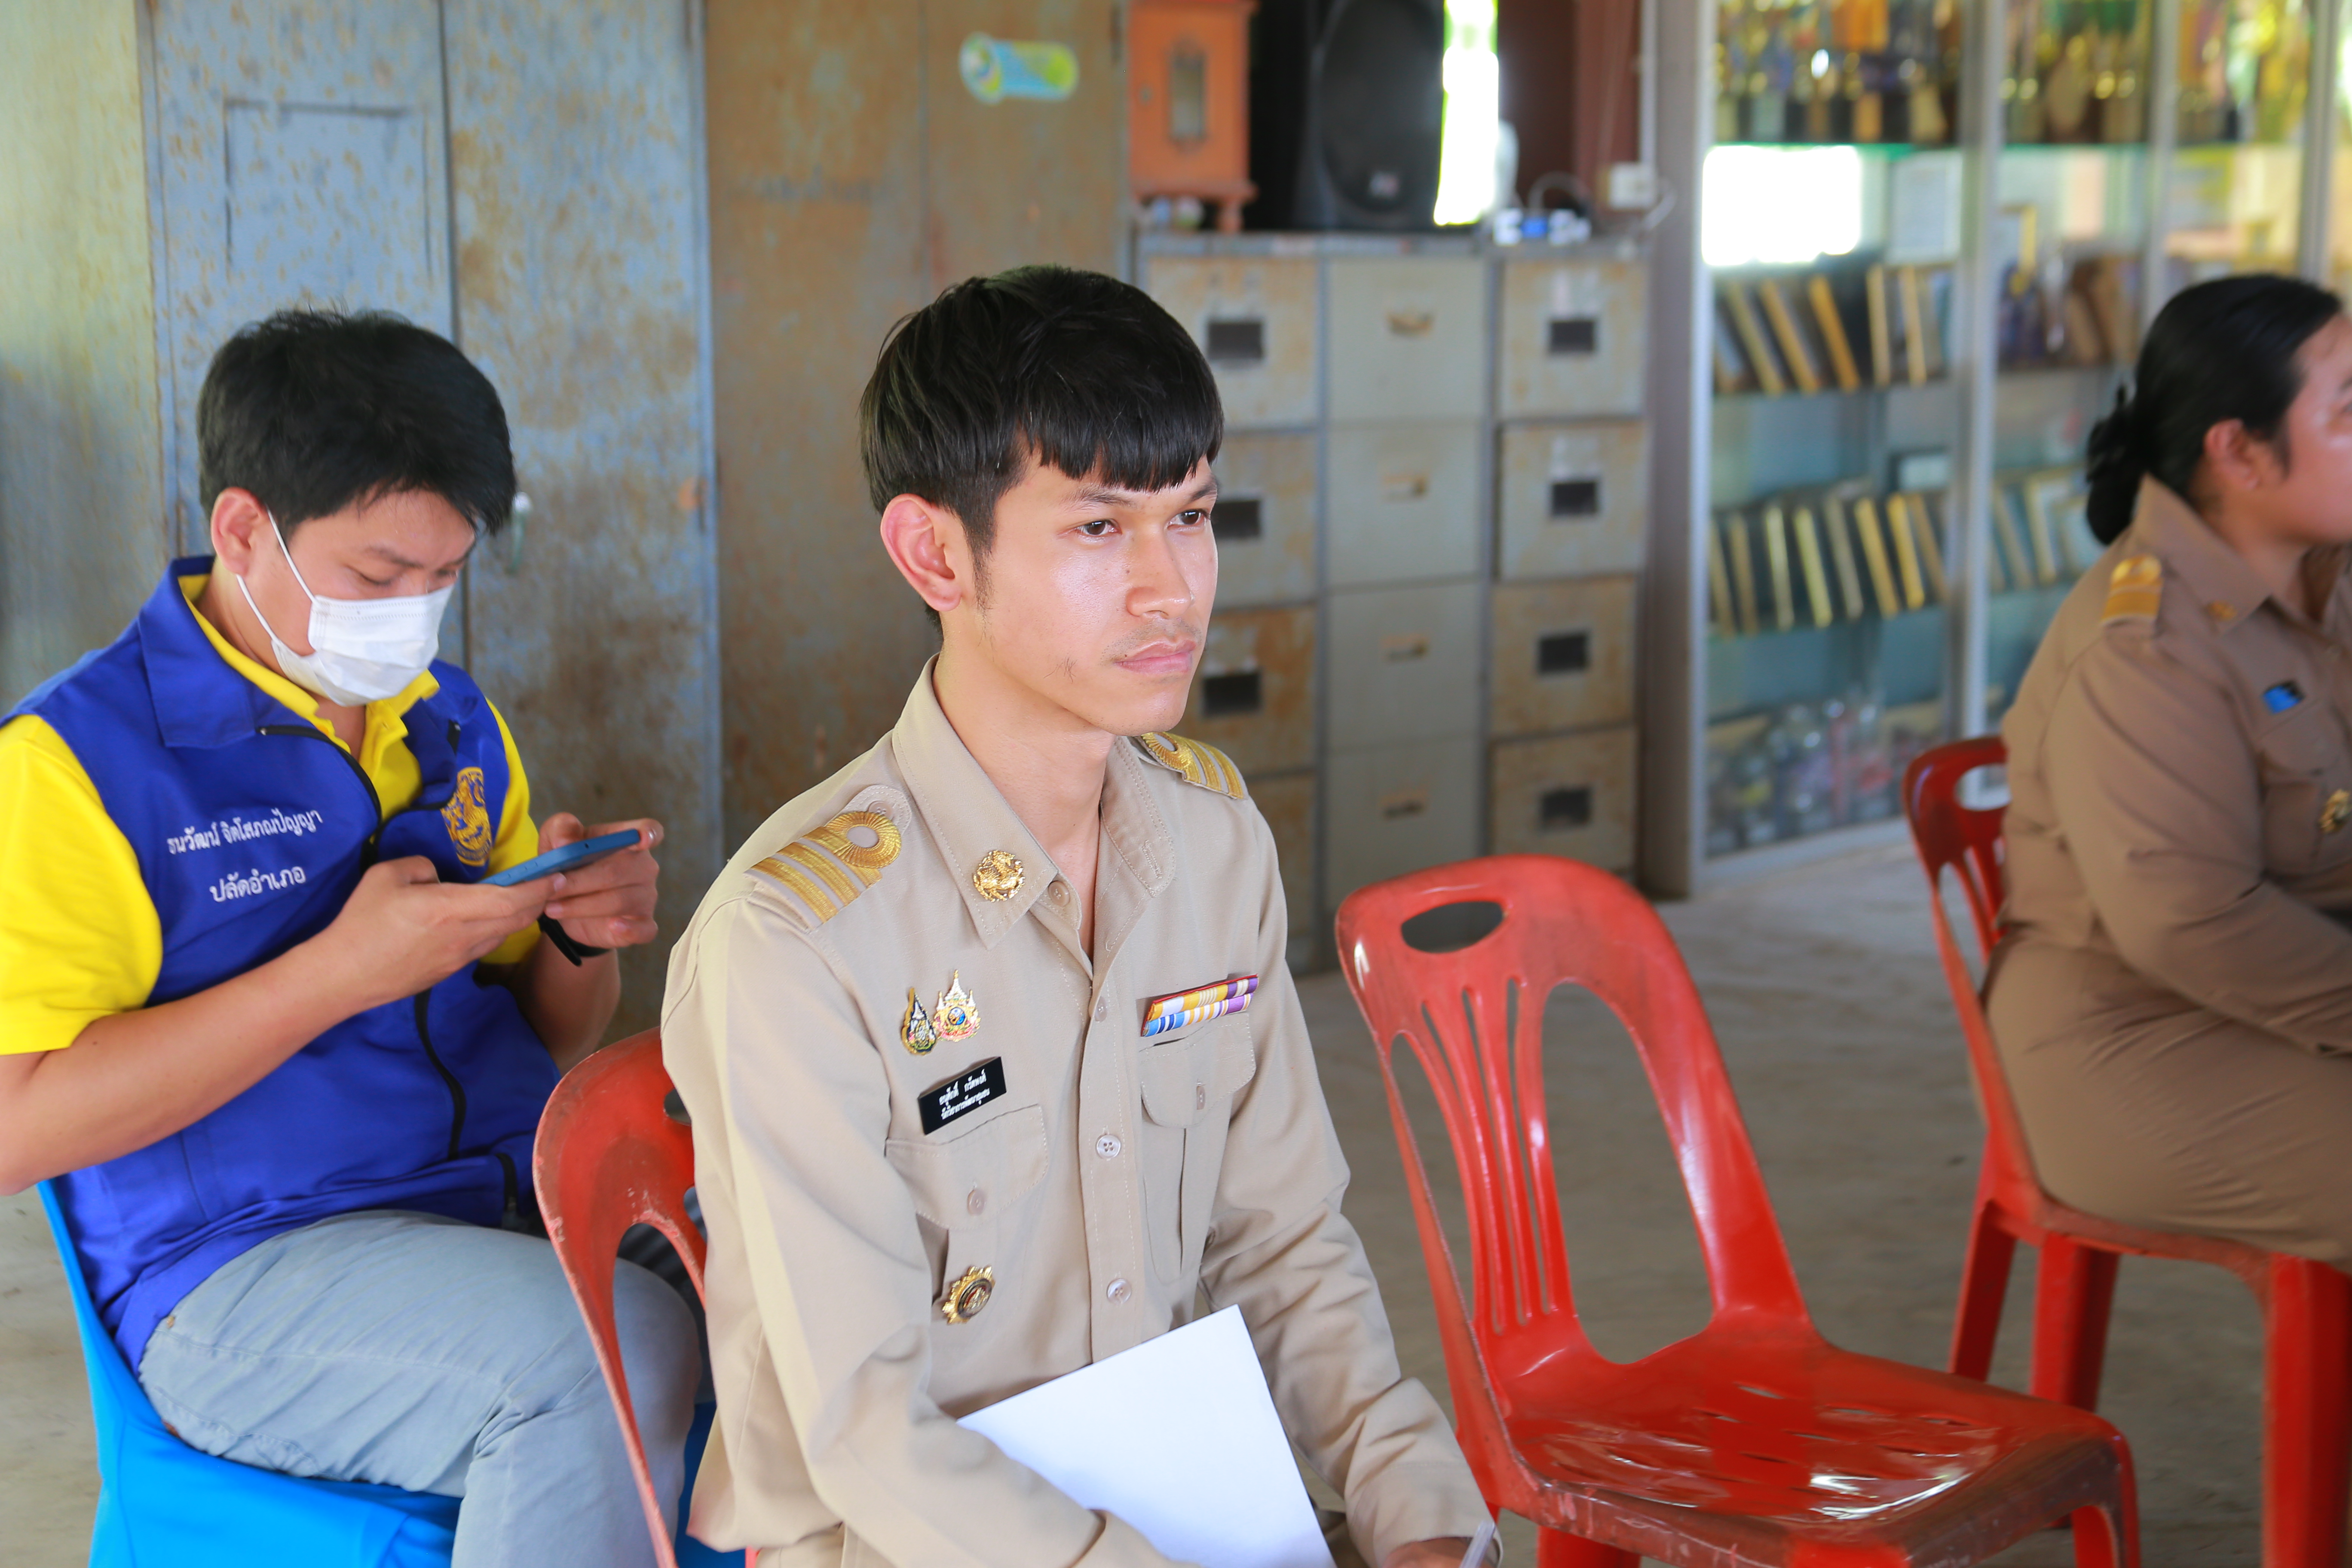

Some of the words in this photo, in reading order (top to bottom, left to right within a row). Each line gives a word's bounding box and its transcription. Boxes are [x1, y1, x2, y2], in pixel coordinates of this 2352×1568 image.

[167, 821, 220, 854] ธนวัฒน์
[209, 866, 306, 902] ปลัดอำเภอ
